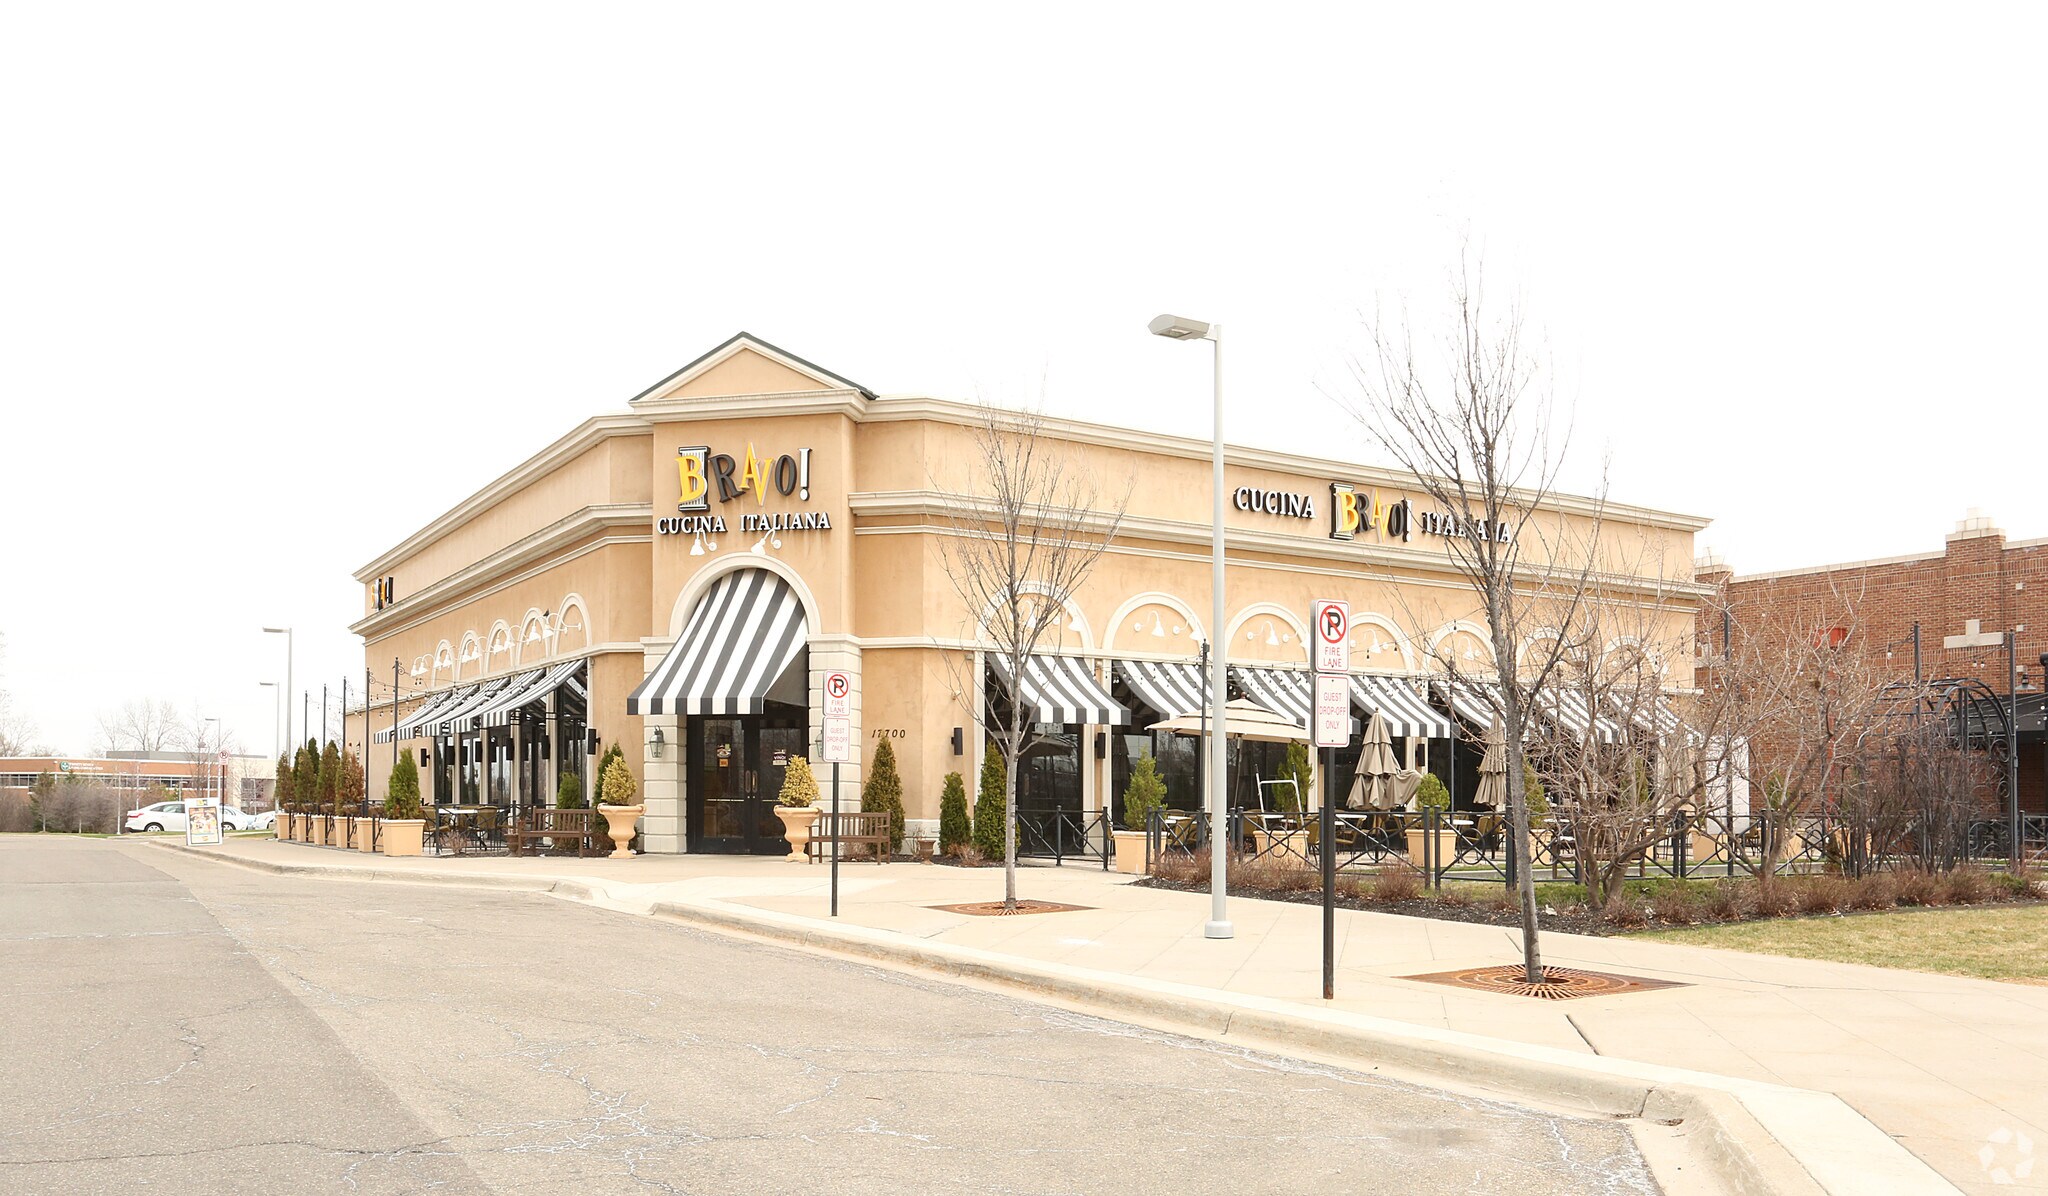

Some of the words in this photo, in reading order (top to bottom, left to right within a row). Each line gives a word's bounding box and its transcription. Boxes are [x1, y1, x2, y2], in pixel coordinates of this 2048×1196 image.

[675, 441, 812, 510] BRAVO!
[1233, 486, 1317, 519] CUCINA
[1329, 484, 1413, 543] BRAVO!
[656, 515, 728, 535] CUCINA
[740, 511, 833, 533] ITALIANA
[1324, 646, 1341, 657] FIRE
[1323, 657, 1342, 667] LANE
[1323, 692, 1342, 702] GUEST
[1319, 705, 1346, 716] DROP-OFF
[1325, 720, 1340, 730] ONLY
[871, 729, 905, 738] 17700
[831, 744, 843, 752] ONLY
